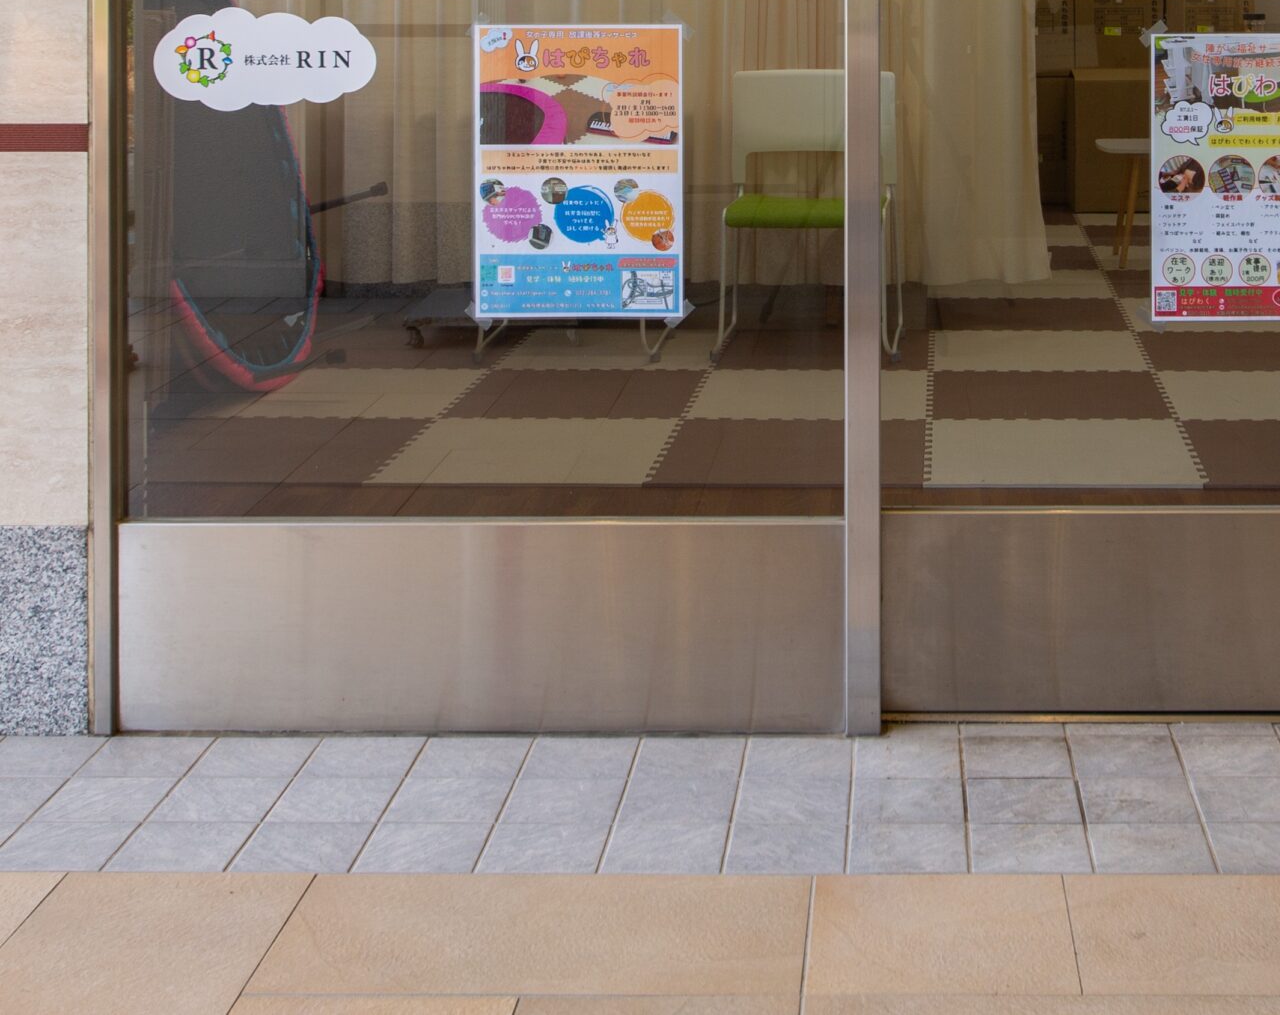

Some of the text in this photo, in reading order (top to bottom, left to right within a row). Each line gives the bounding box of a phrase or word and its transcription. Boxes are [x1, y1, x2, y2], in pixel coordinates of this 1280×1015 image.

[244, 50, 351, 69] 株式会社 RIN
[543, 47, 650, 68] はぴちゃれ
[1171, 257, 1187, 265] 在宅
[1208, 258, 1225, 266] 送迎
[1245, 257, 1261, 265] 食事
